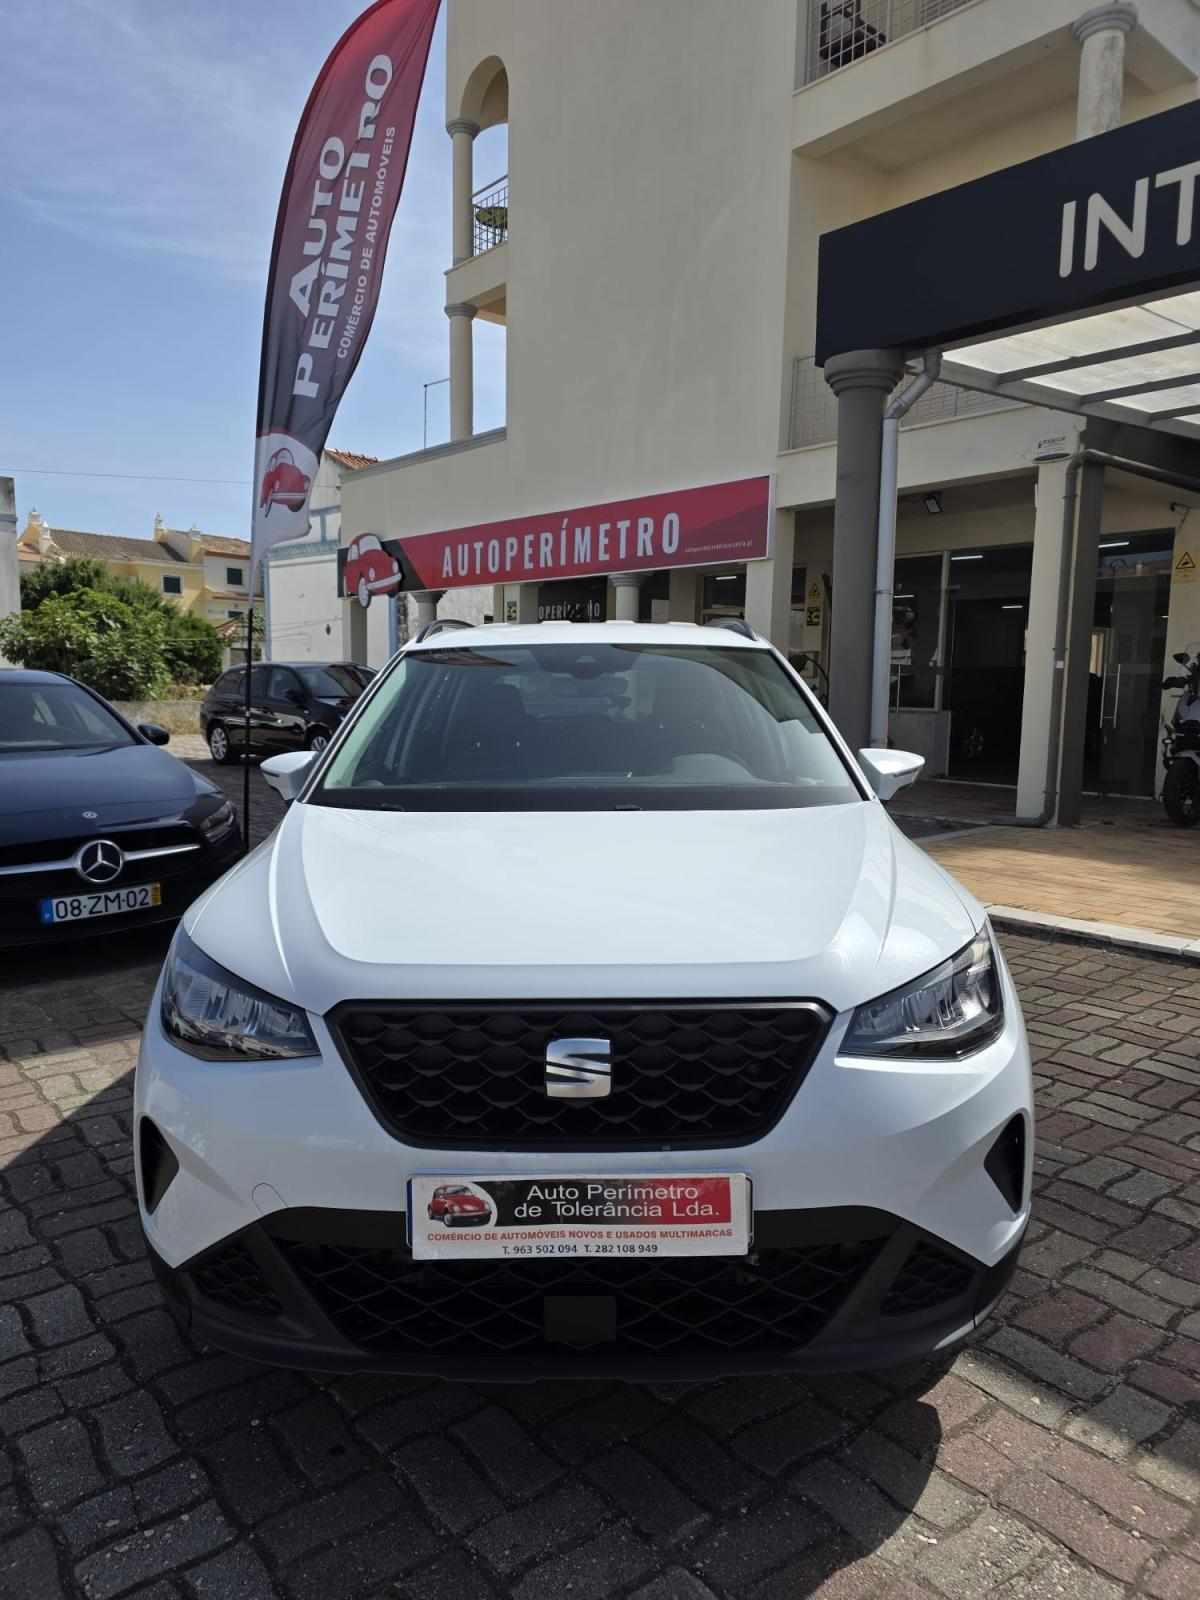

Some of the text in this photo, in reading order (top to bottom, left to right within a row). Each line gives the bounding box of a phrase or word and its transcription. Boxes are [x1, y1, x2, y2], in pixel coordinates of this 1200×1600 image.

[289, 136, 345, 318] AUTO
[1059, 160, 1200, 278] INT
[337, 126, 395, 358] COMÉRCIO DE AUTOMÓVEIS
[442, 511, 681, 578] AUTOPERÍMETRO
[514, 1201, 720, 1218] de Tolerância Lda.
[526, 1184, 699, 1201] Auto Perímetro
[427, 1228, 733, 1241] COMÉRCIO DE AUTOMÓVEIS NOVOS E USADOS MULTIMARCAS
[502, 1244, 659, 1255] T. 963 502 094 T. 282 108 949
